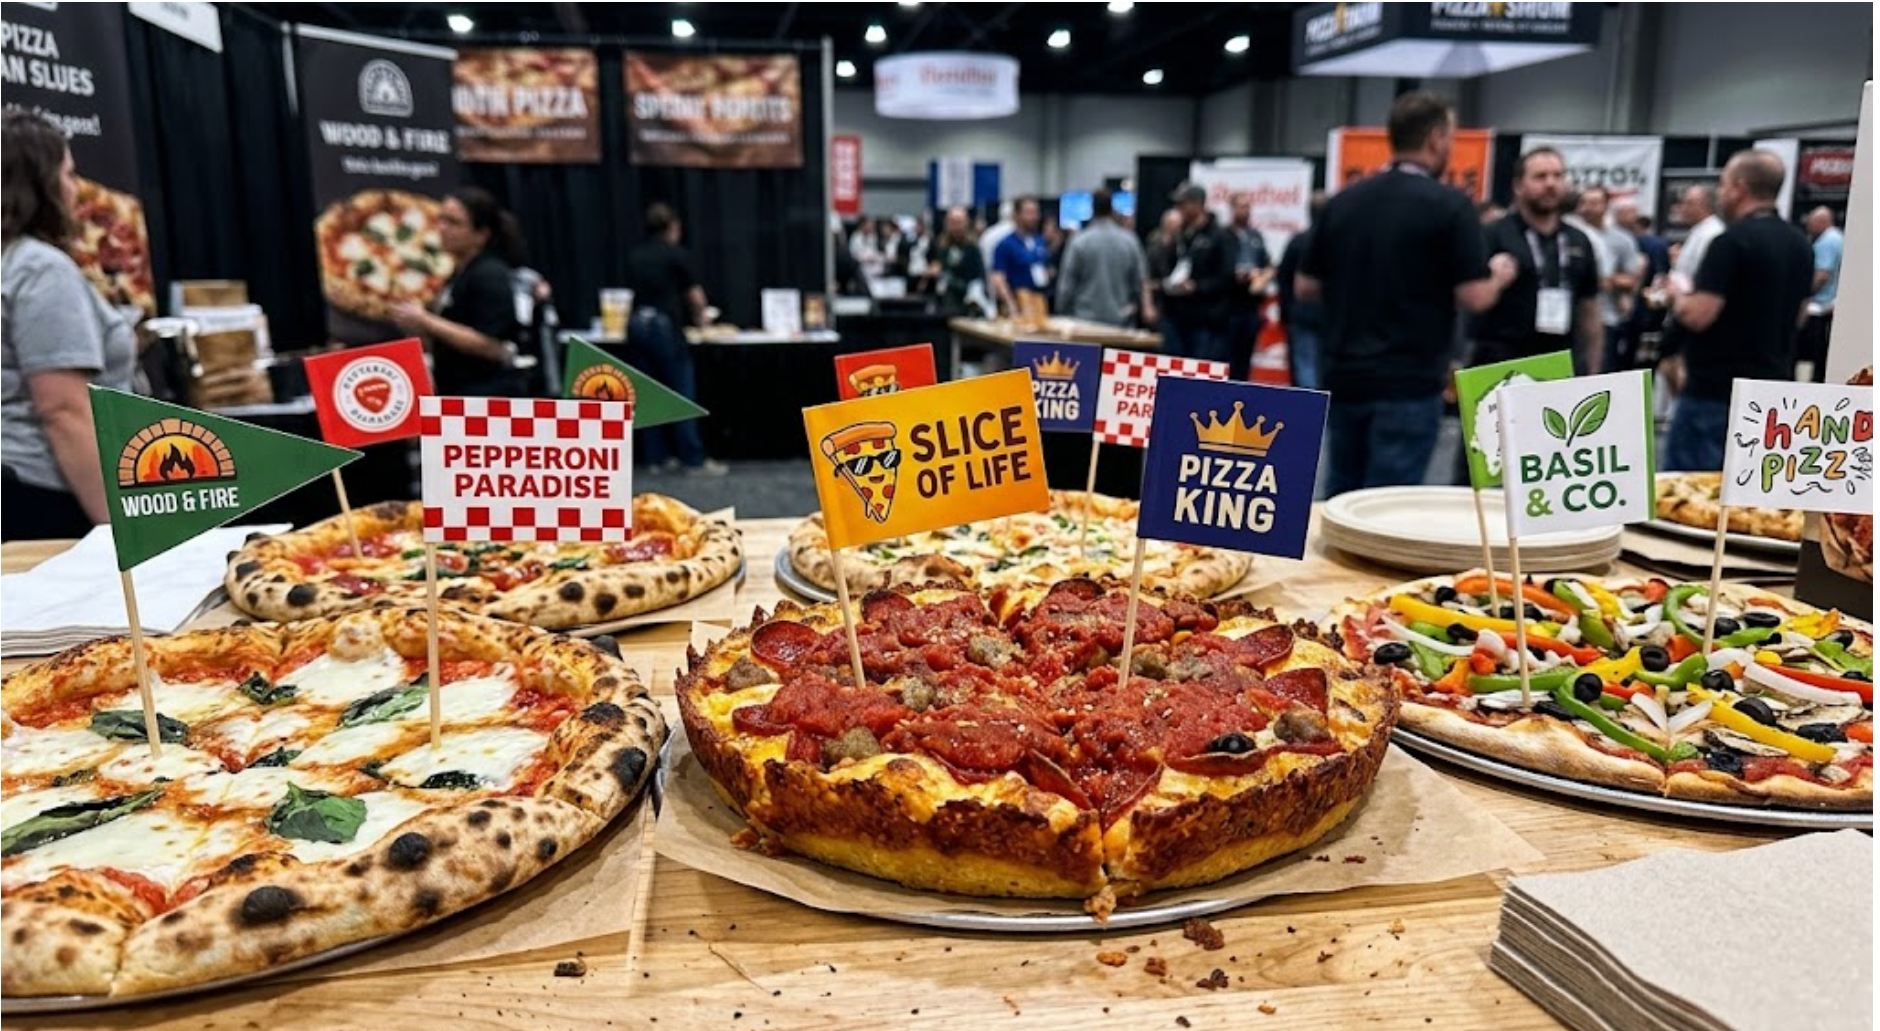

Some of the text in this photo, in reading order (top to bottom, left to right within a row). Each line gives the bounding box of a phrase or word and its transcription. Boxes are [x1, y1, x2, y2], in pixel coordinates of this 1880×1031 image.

[1, 20, 60, 58] PIZZA
[29, 58, 95, 97] SLUES
[319, 121, 383, 148] WOOD
[403, 128, 451, 153] FIRE
[1032, 380, 1080, 399] PIZZA
[1116, 401, 1153, 418] PAR
[910, 405, 1027, 462] SLICE
[443, 445, 619, 471] PEPPERONI
[917, 450, 1031, 499] OF LIFE
[1178, 454, 1278, 494] PIZZA
[1520, 445, 1630, 484] BASIL
[121, 486, 240, 518] WOOD & FIRE
[455, 474, 610, 499] PARADISE
[1525, 480, 1627, 517] & CO.
[1173, 487, 1276, 533] KING
